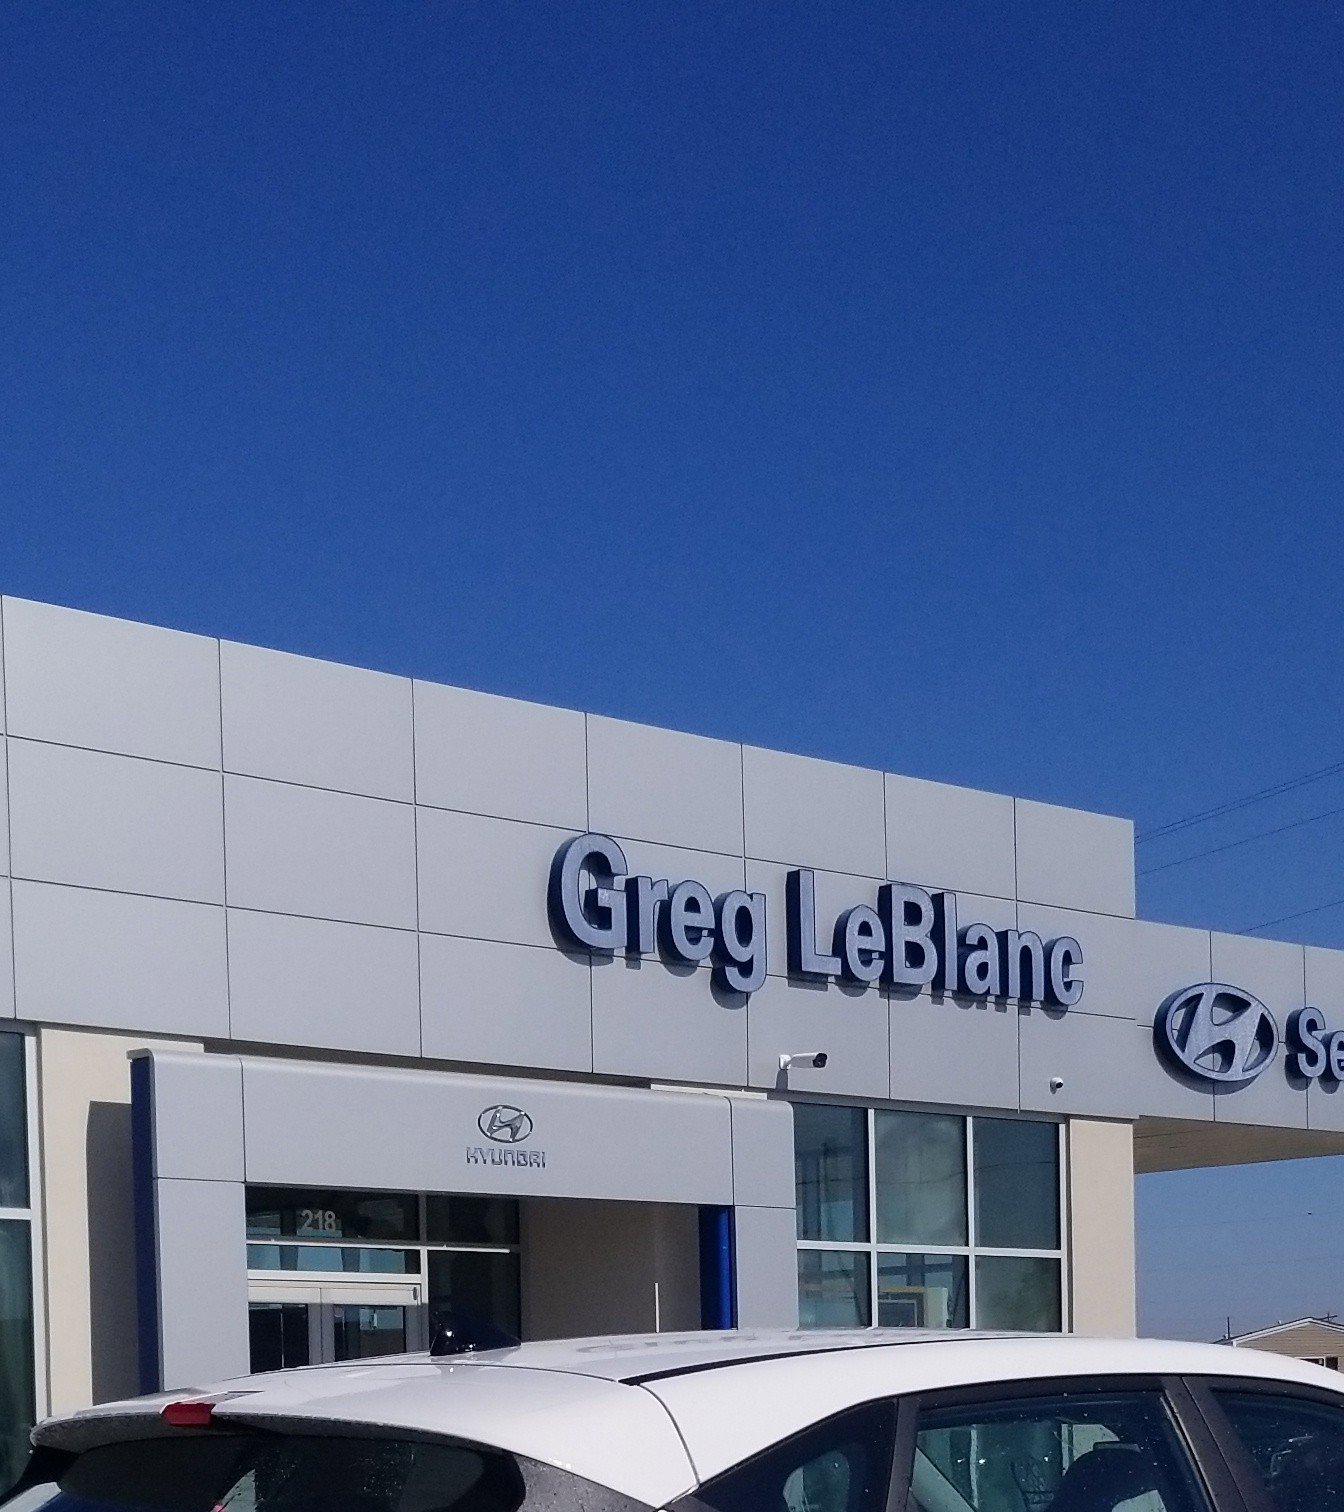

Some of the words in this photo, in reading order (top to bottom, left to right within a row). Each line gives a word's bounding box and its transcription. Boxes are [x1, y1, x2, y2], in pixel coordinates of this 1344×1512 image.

[548, 832, 767, 993] Greg
[786, 869, 1084, 1006] LeBlanc
[466, 1146, 546, 1169] HYUNDAI
[301, 1209, 336, 1231] 218
